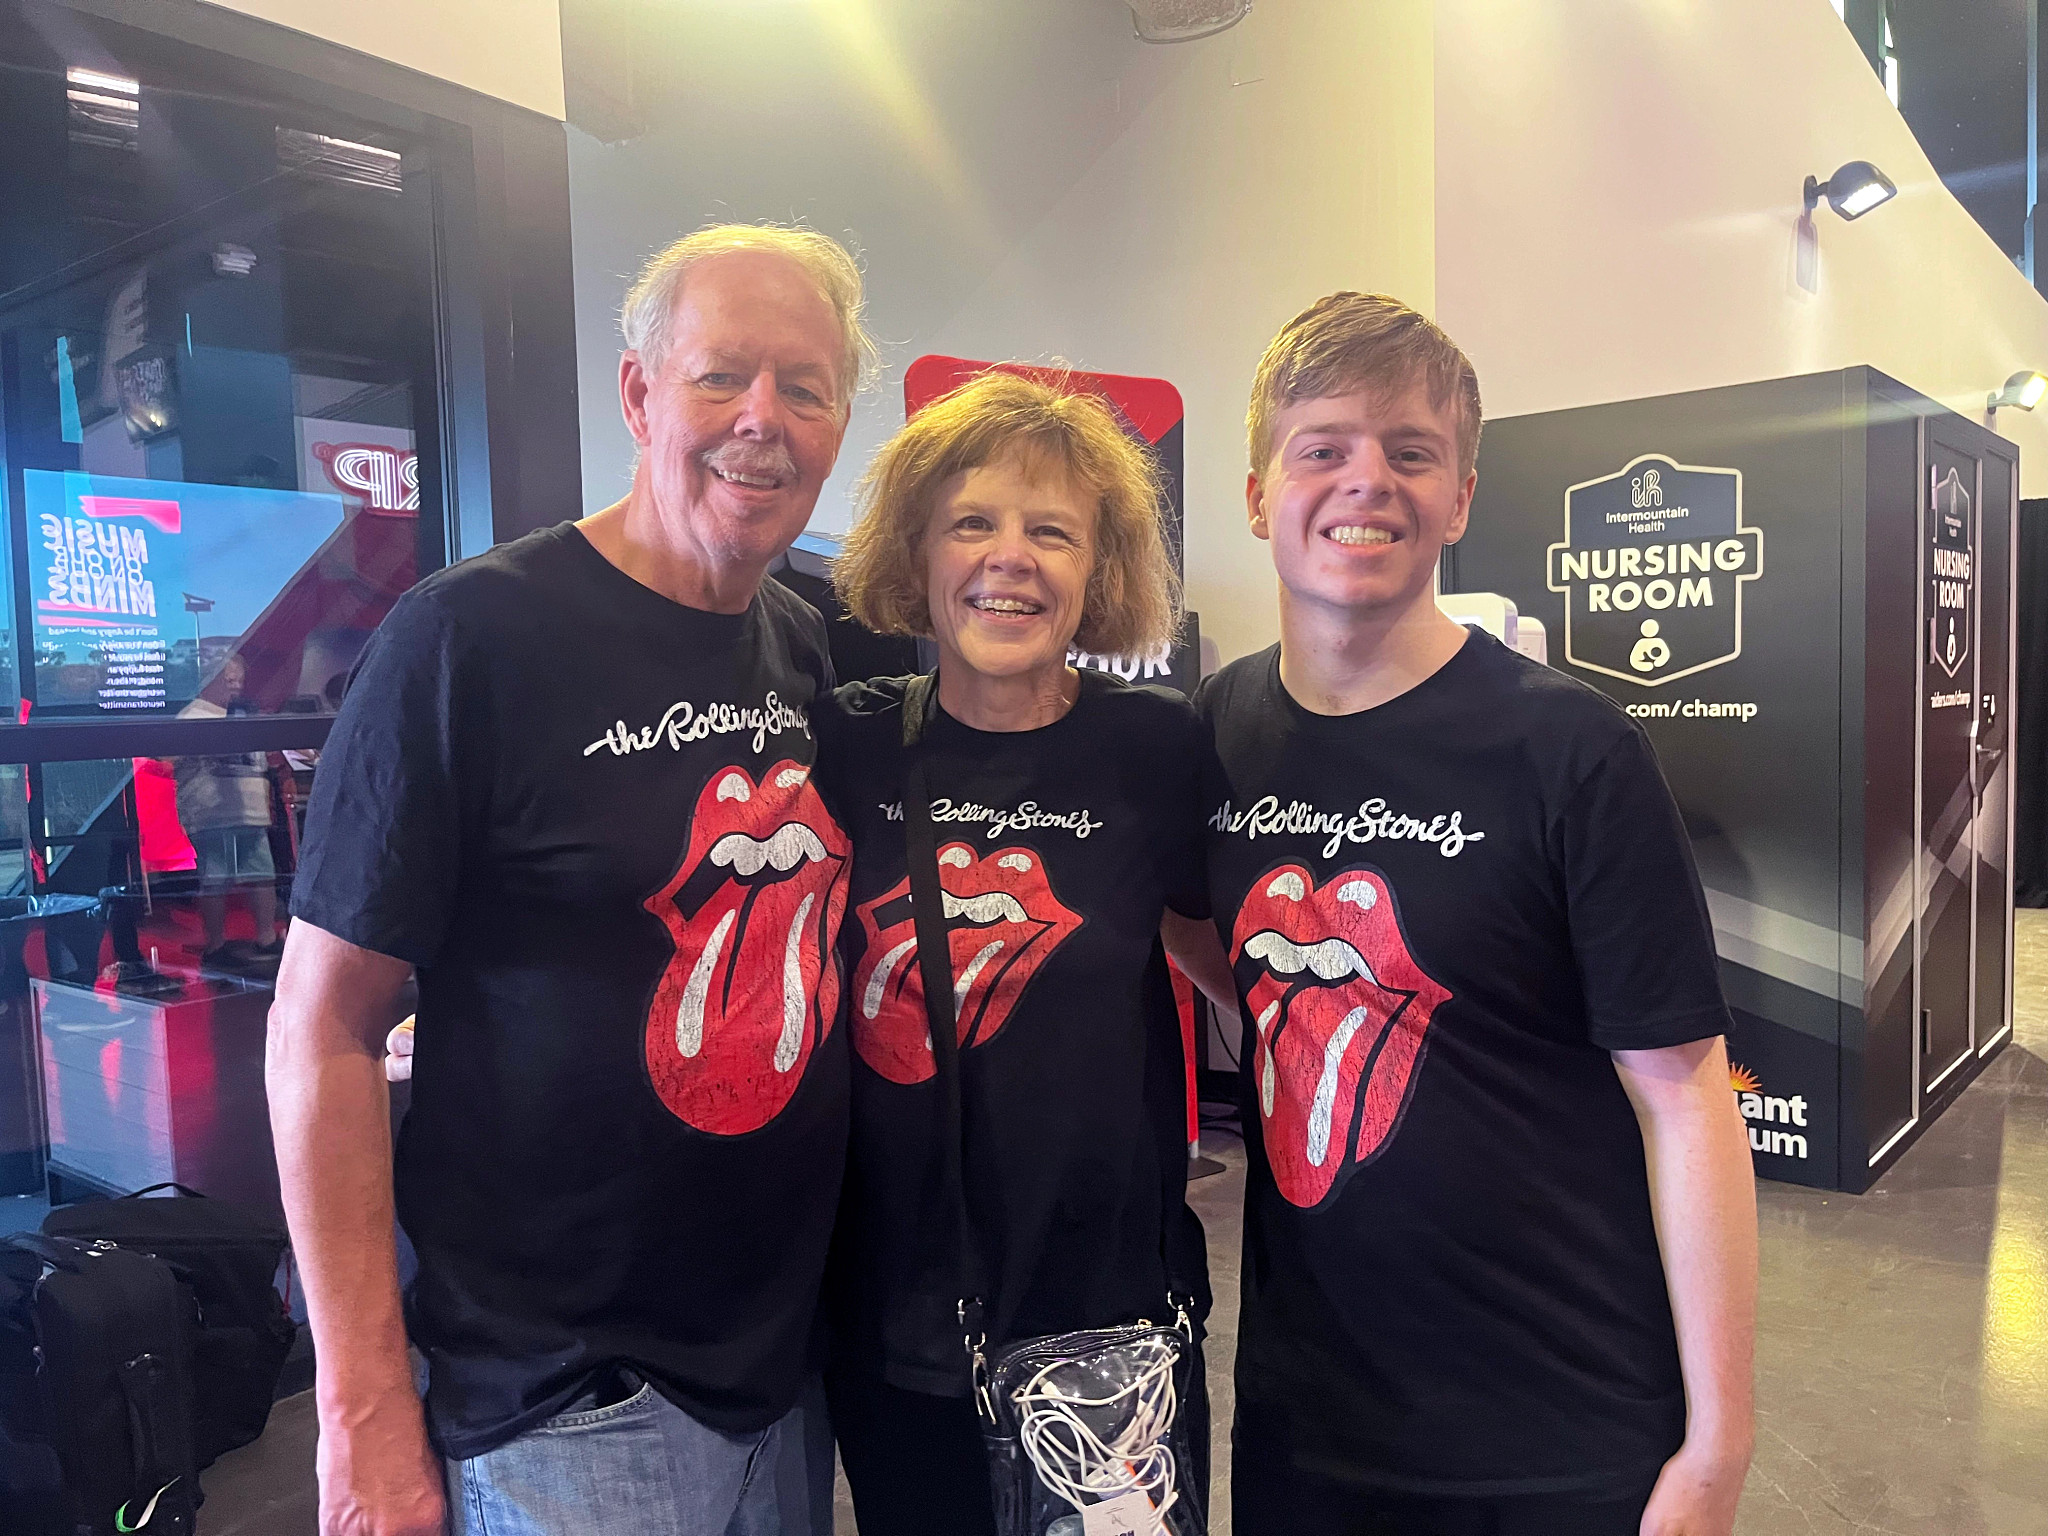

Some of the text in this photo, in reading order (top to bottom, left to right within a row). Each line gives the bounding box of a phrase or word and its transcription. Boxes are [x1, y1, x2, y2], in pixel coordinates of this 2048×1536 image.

[1606, 506, 1689, 524] Intermountain
[1628, 521, 1665, 534] Health
[1561, 539, 1746, 580] NURSING
[1933, 548, 1970, 580] NURSING
[1588, 577, 1714, 612] ROOM
[1939, 580, 1964, 609] ROOM
[583, 720, 652, 756] the
[650, 701, 768, 754] Rolling
[878, 798, 1103, 839] th Rolling Stones
[1208, 796, 1486, 858] the Rolling Stones
[1746, 1126, 1808, 1159] um
